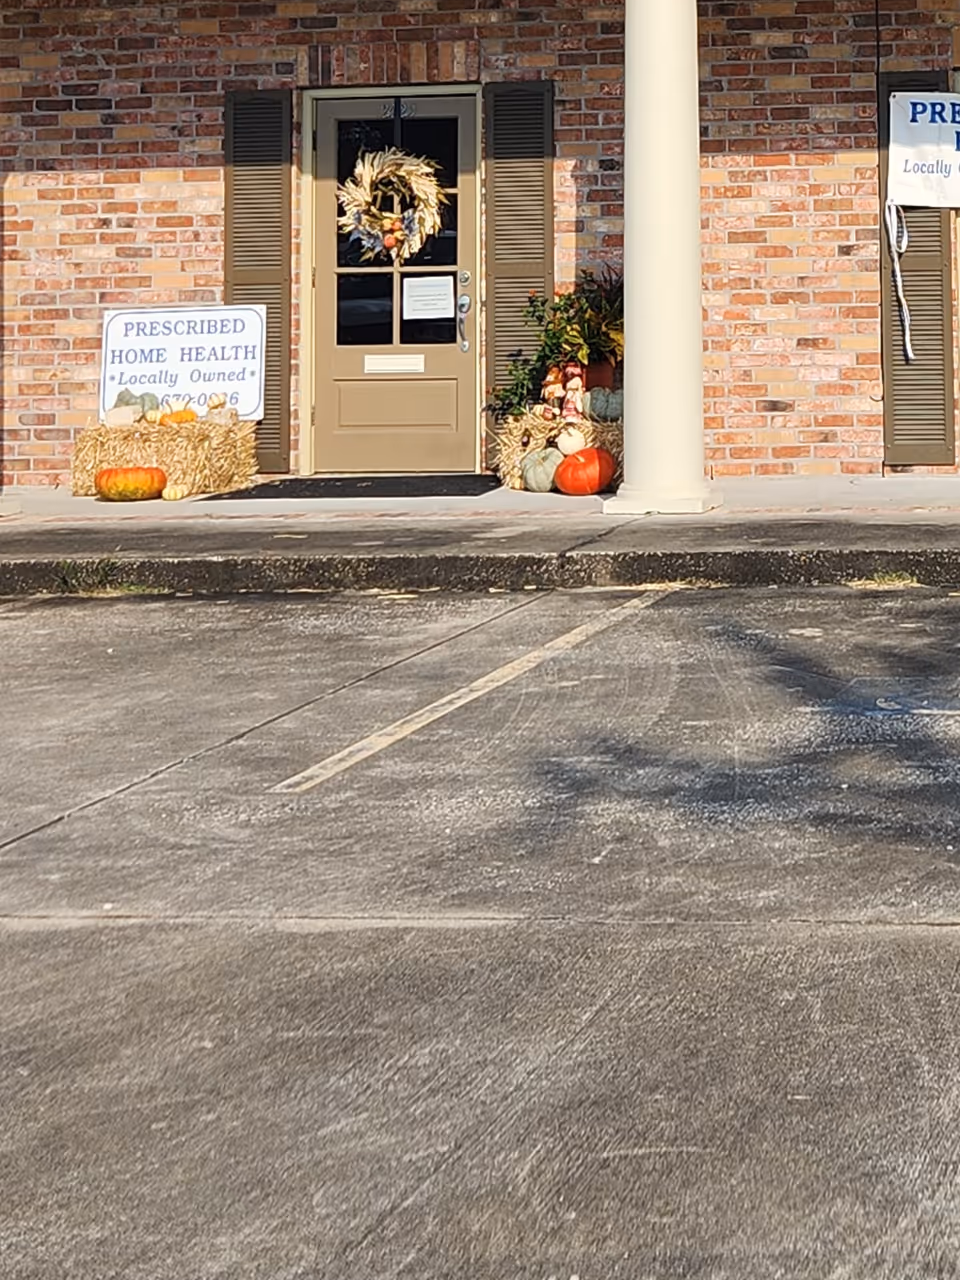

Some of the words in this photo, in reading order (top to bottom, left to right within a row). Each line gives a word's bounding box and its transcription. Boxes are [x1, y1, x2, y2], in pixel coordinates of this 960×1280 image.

[903, 159, 952, 178] Locally
[123, 318, 246, 337] PRESCRIBED
[110, 348, 168, 365] HOME
[179, 345, 257, 363] HEALTH
[117, 369, 179, 388] Locally
[189, 367, 247, 383] Owned
